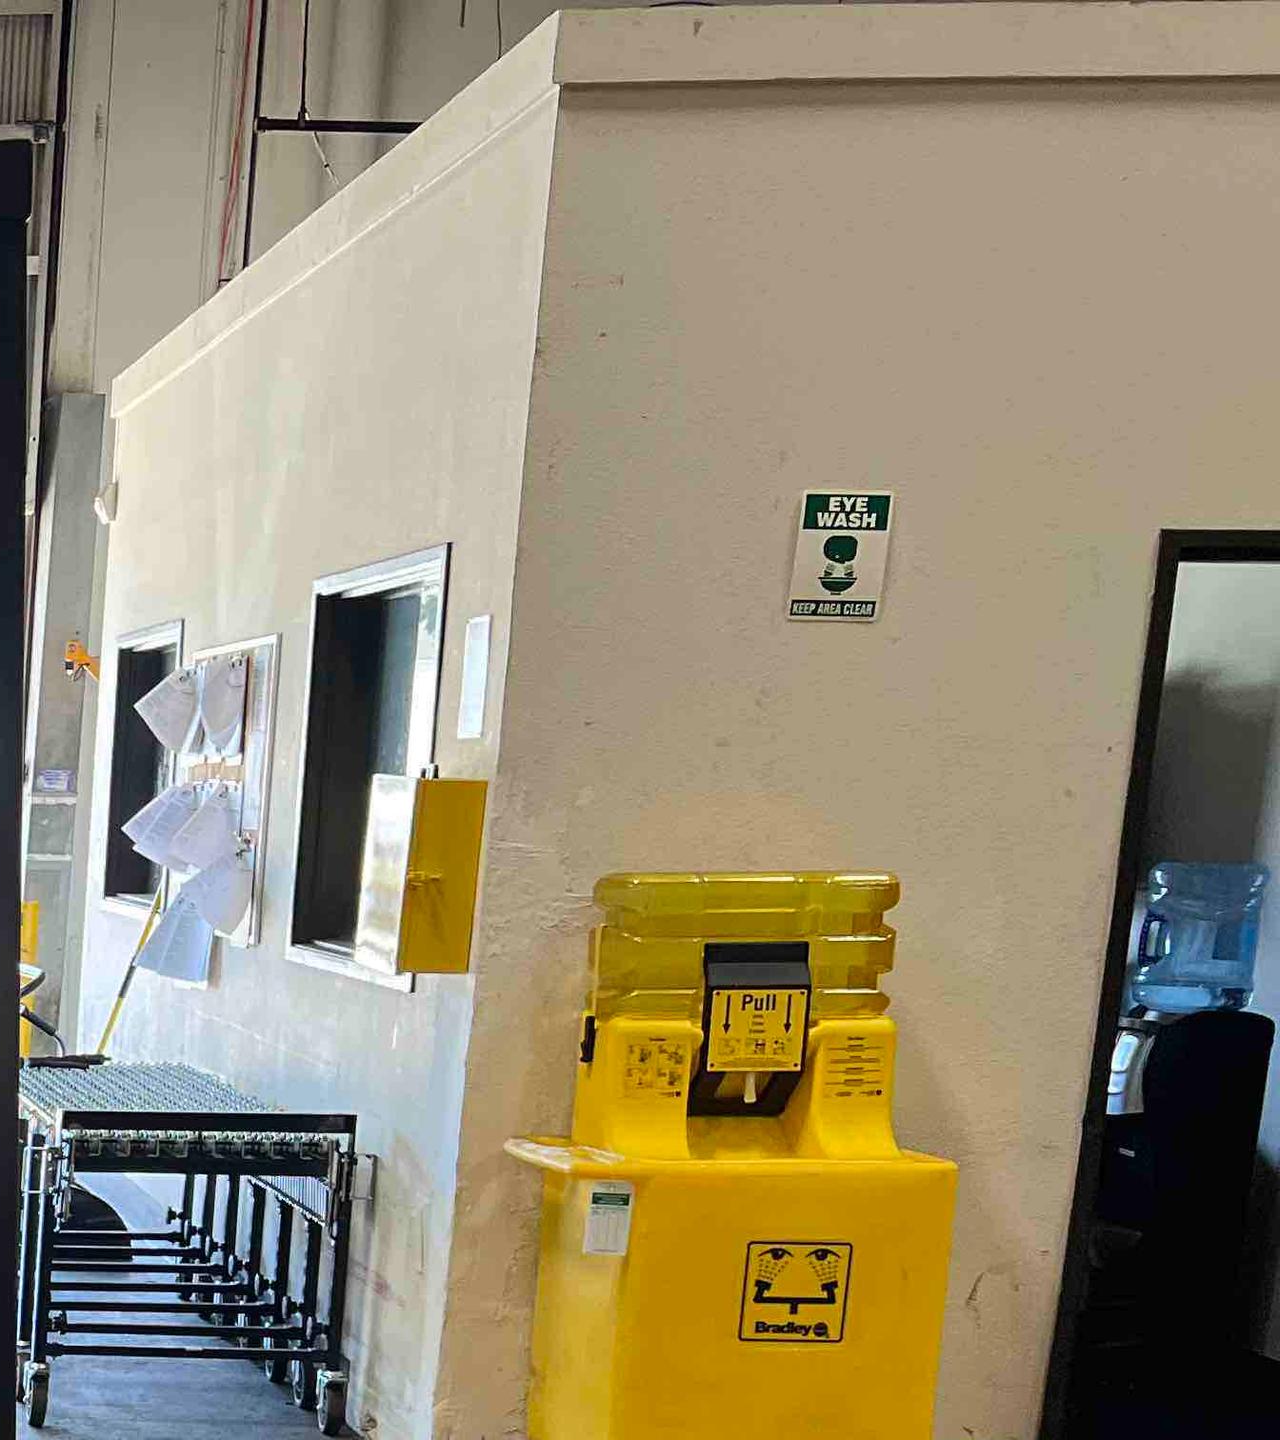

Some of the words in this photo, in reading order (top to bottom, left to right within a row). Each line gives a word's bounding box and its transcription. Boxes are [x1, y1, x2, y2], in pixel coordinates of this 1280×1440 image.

[828, 496, 868, 512] EYE
[817, 512, 877, 528] WASH
[792, 602, 816, 615] KEEP
[817, 603, 841, 615] AREA
[843, 603, 874, 616] CLEAR
[741, 994, 776, 1011] Pull
[755, 1321, 812, 1337] Bradley
